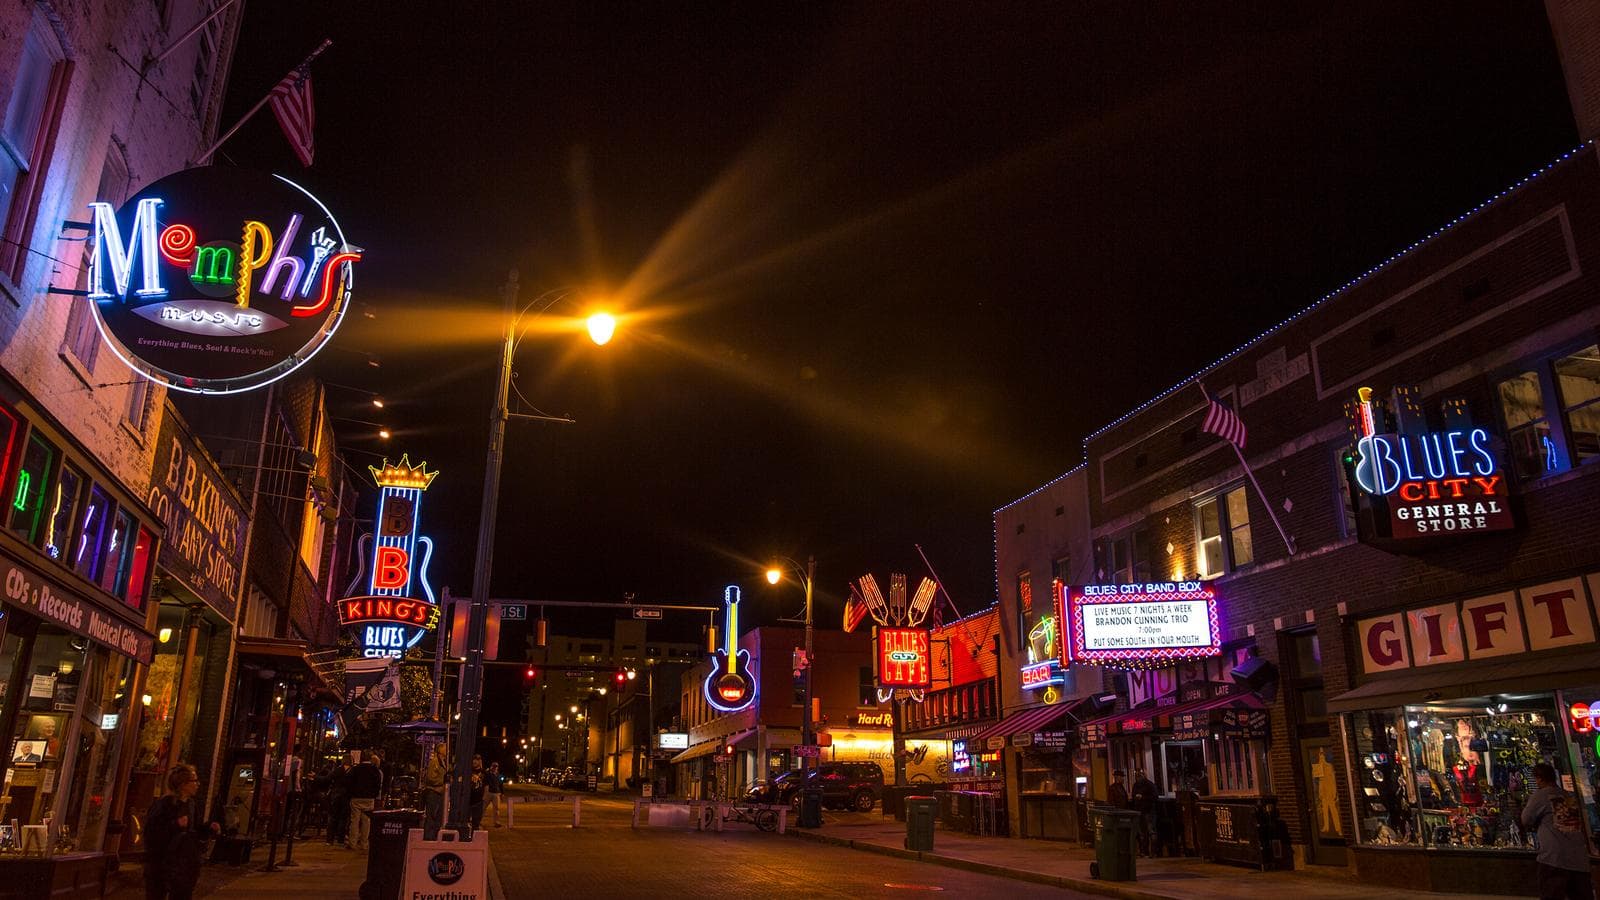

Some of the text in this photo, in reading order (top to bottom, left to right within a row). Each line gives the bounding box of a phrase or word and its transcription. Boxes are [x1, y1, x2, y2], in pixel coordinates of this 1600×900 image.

[88, 198, 361, 316] Memphis
[138, 337, 179, 350] Everything
[181, 341, 203, 351] Blues,
[205, 343, 223, 352] Soul
[1373, 428, 1494, 494] BLUES
[1400, 476, 1501, 502] CITY
[1397, 501, 1502, 520] GENERAL
[1416, 517, 1487, 533] STORE
[206, 543, 236, 602] STORE
[373, 546, 410, 590] B
[1084, 581, 1202, 596] BLUES CITY BAND BOX
[5, 567, 140, 657] CDs Records Musical Gifts
[508, 606, 521, 618] St
[1094, 604, 1192, 616] LIVE MUSIC 7 NIGHTS A WEEK
[1095, 615, 1188, 626] BRANDON CUNNING TRIO
[1366, 588, 1577, 667] GIFT
[364, 626, 405, 648] BLUES
[1139, 626, 1162, 634] 7:00pm
[883, 631, 927, 652] BLUES
[1093, 635, 1200, 647] PUT SOME SOUTH IN YOUR MOUTH
[364, 648, 403, 660] CLUB
[884, 654, 927, 683] CAFE
[1022, 665, 1051, 685] BAR
[1214, 684, 1229, 696] LATE
[857, 712, 883, 725] Hard
[412, 891, 477, 900] Everything
